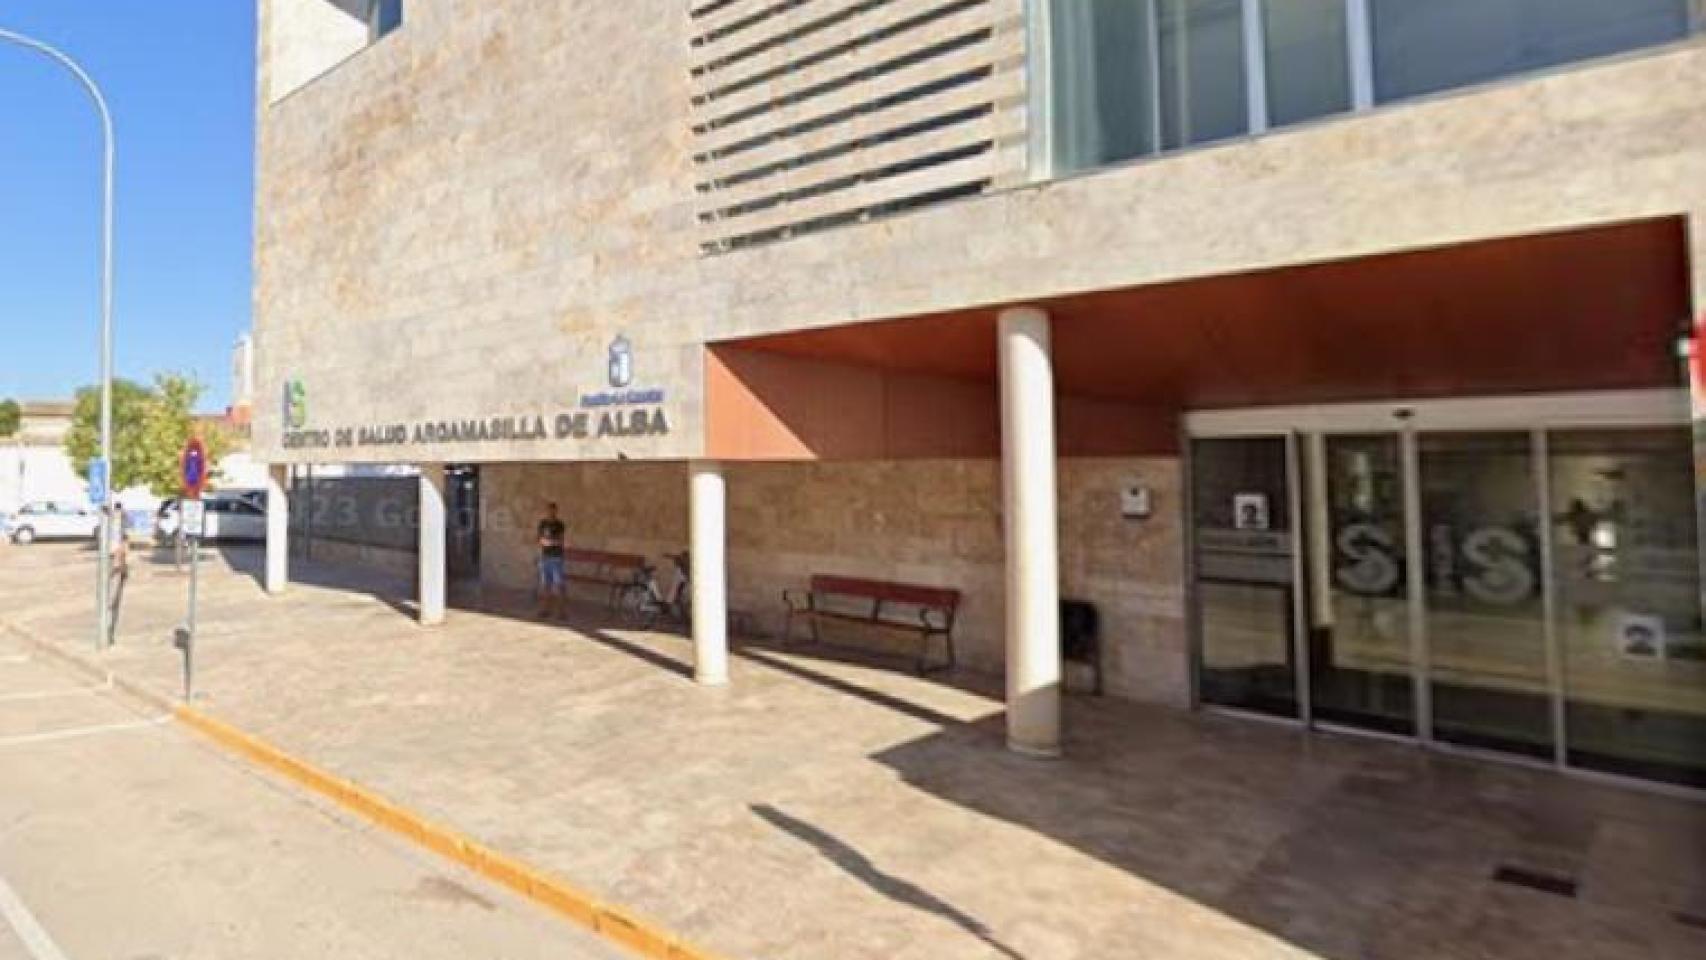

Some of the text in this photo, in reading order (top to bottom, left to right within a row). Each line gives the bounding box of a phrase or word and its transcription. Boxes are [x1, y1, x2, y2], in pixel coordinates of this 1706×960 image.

[335, 427, 353, 448] DE
[358, 423, 406, 446] SALUD
[555, 411, 588, 439] DE
[598, 406, 669, 438] ALBA
